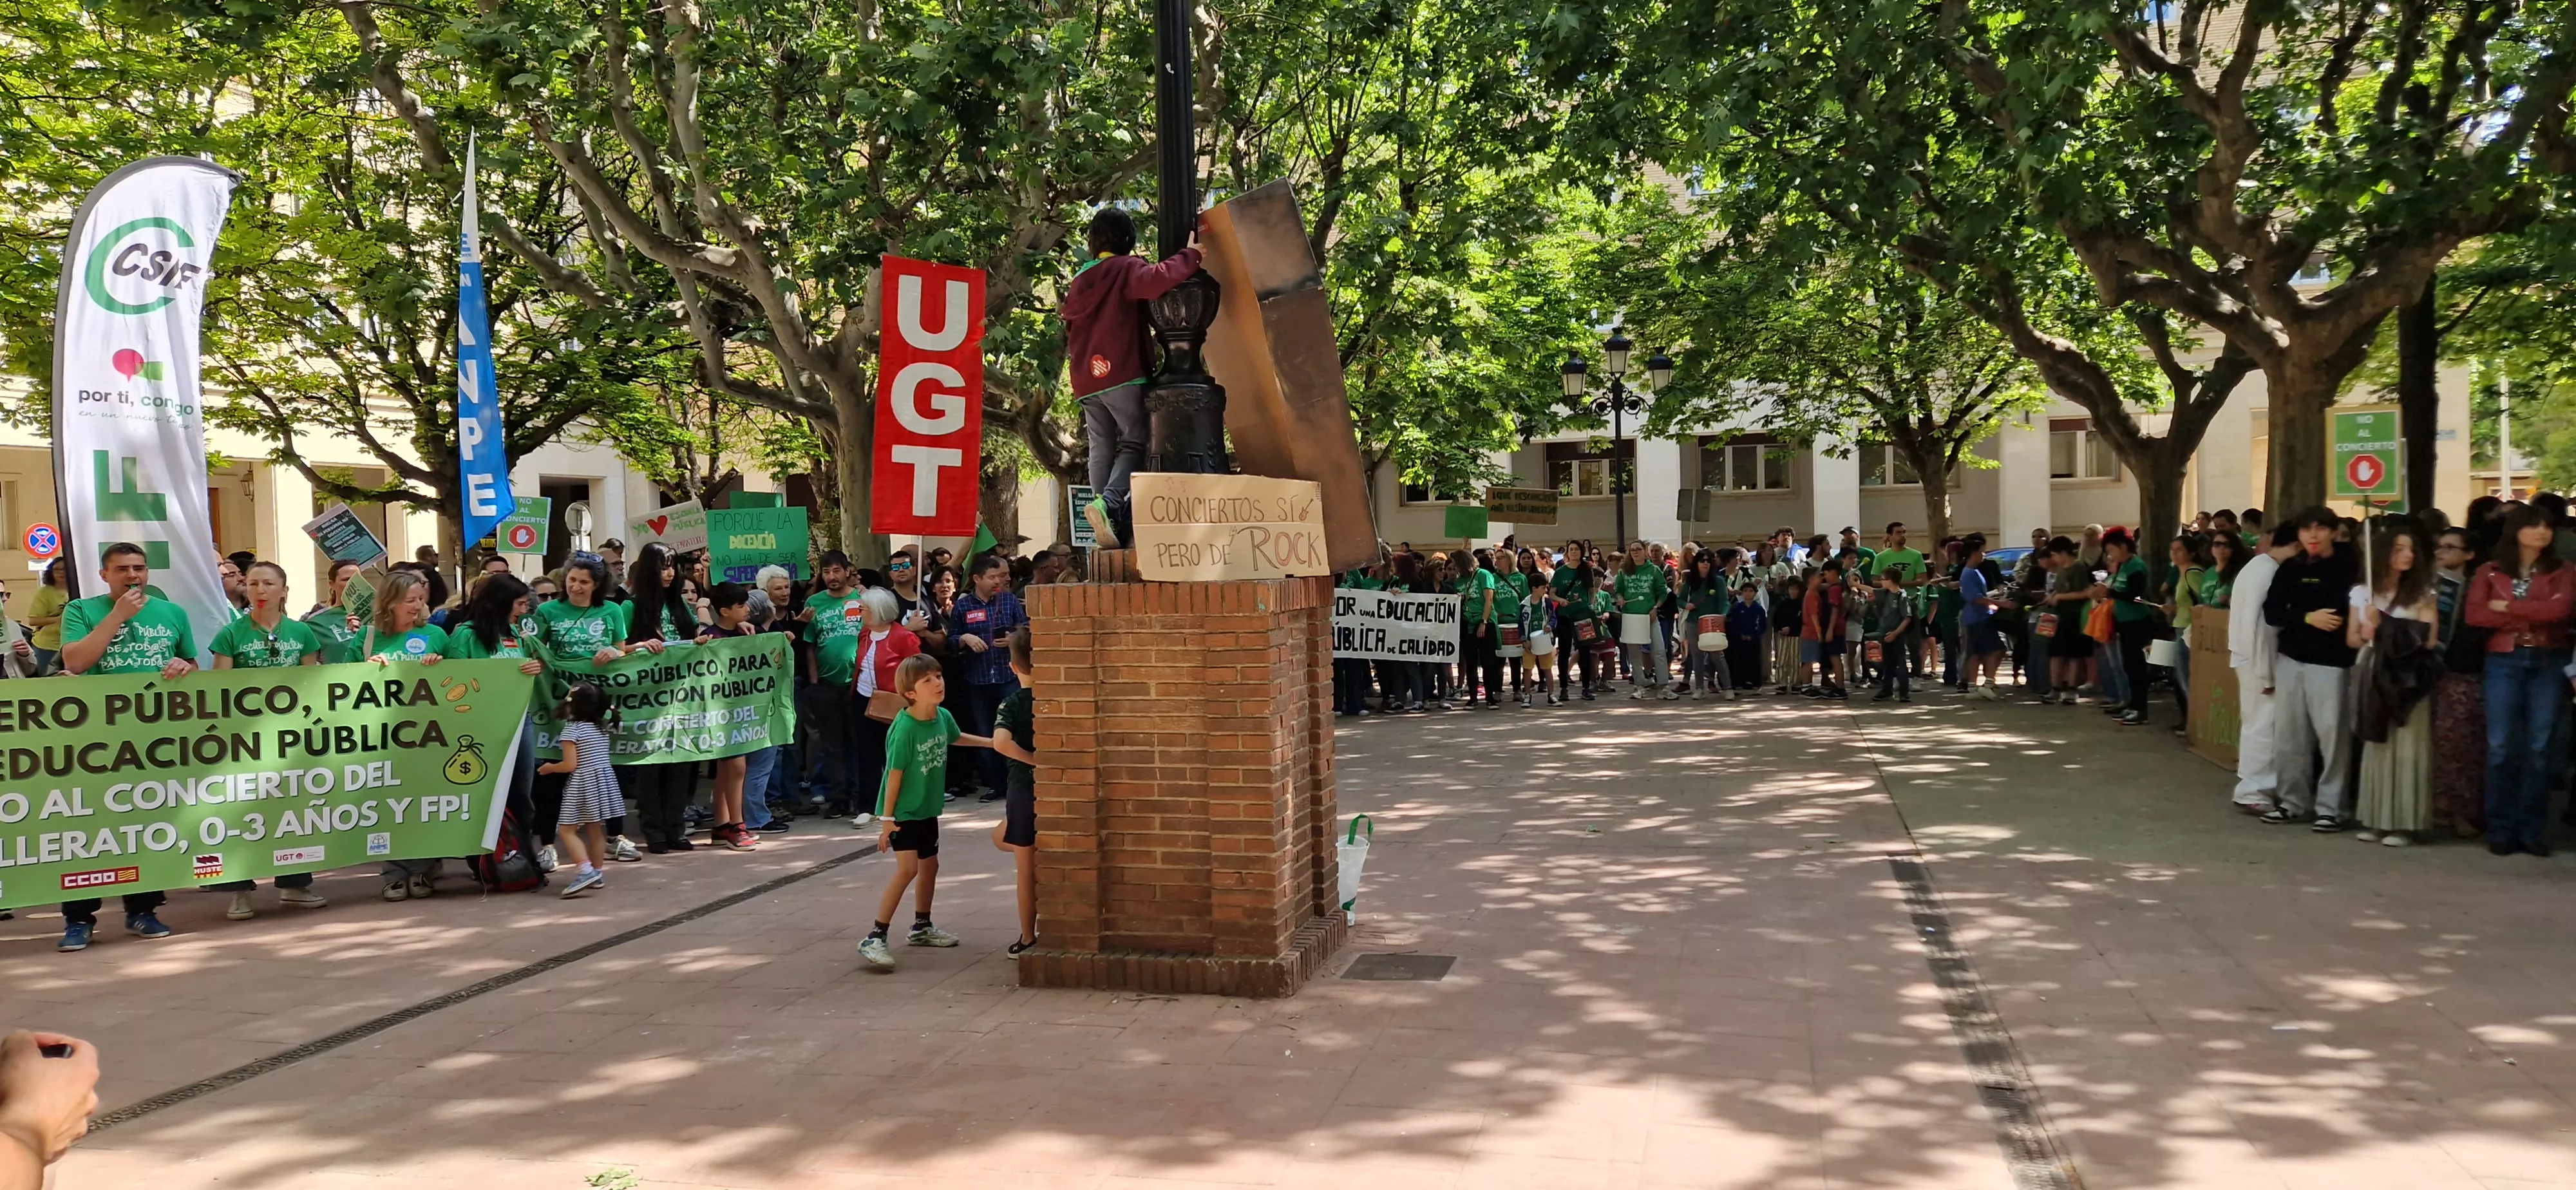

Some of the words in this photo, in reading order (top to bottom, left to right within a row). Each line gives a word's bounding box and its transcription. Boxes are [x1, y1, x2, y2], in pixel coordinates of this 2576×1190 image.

[112, 243, 202, 290] CSIF
[79, 390, 112, 404] por
[891, 274, 969, 516] UGT
[2356, 415, 2374, 424] NO
[2357, 429, 2372, 438] AL
[2336, 441, 2396, 451] CONCIERTO
[502, 516, 547, 524] ONCIERTO
[1150, 496, 1265, 524] CONCIERTOS
[1276, 494, 1298, 522] SÍ
[714, 512, 766, 532] PORQUE
[777, 512, 793, 530] LA
[716, 554, 732, 566] NO
[739, 553, 753, 565] HA
[759, 552, 772, 564] DE
[779, 552, 797, 562] SER
[1153, 542, 1201, 569] PERO
[1208, 543, 1234, 566] DE
[1236, 525, 1322, 572] ROCK
[345, 581, 361, 601] NO!
[1334, 596, 1356, 617] OR
[1359, 609, 1376, 619] UNA
[138, 625, 173, 638] PÚBLICA
[1332, 621, 1387, 652] ÚBLICA
[1387, 646, 1396, 654] DE
[106, 644, 122, 654] DE
[129, 643, 166, 653] TOD@S
[636, 659, 723, 686] PÚBLICO,
[728, 652, 773, 674] PARA
[711, 675, 775, 700] PÚBLICA
[105, 681, 312, 726] PÚBLICO,
[327, 678, 439, 712] PARA
[632, 709, 730, 735] CONCIERTO
[733, 705, 760, 723] DEL
[698, 731, 727, 750] 0-3
[730, 722, 768, 745] AÑOS!
[0, 723, 261, 782] DUCACIÓN
[277, 717, 450, 759] PÚBLICA
[39, 787, 95, 820] AL
[104, 767, 335, 813] CONCIERTO
[344, 760, 402, 793] DEL
[199, 813, 267, 846] 0-3
[273, 798, 379, 838] AÑOS
[386, 797, 414, 824] Y
[420, 794, 470, 823] FP!
[275, 853, 294, 862] UGT
[64, 871, 116, 887] CCOO
